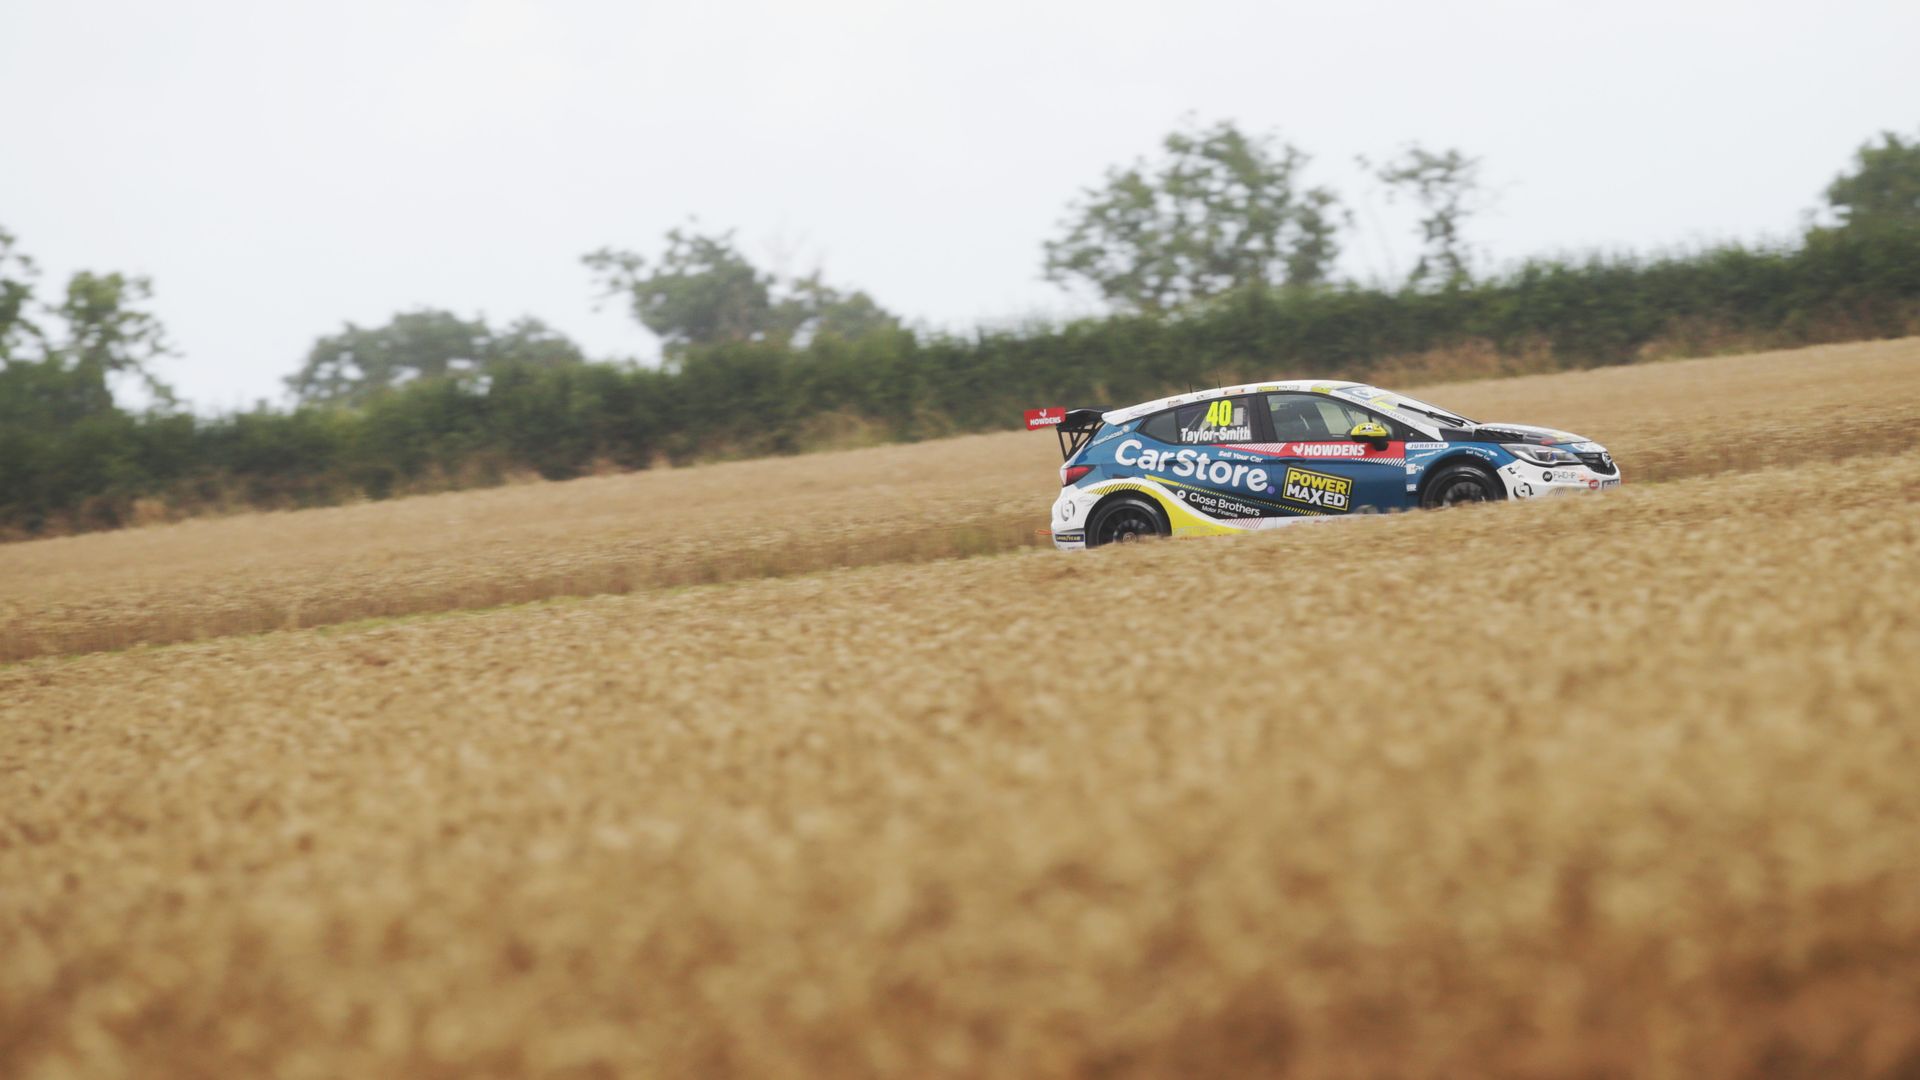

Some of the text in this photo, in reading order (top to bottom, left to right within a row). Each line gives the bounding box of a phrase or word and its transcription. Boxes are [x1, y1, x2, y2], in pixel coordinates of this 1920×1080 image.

[1030, 416, 1062, 426] HOWDENS
[1206, 400, 1232, 427] 40
[1181, 427, 1252, 443] Taylor-Smith
[1218, 450, 1232, 458] Sell
[1233, 453, 1249, 461] Your
[1303, 444, 1365, 456] HOWDENS
[1288, 471, 1347, 495] POWER
[1286, 484, 1345, 506] MAXED
[1189, 492, 1261, 517] Close Brothers
[1201, 505, 1238, 518] Motor Finance
